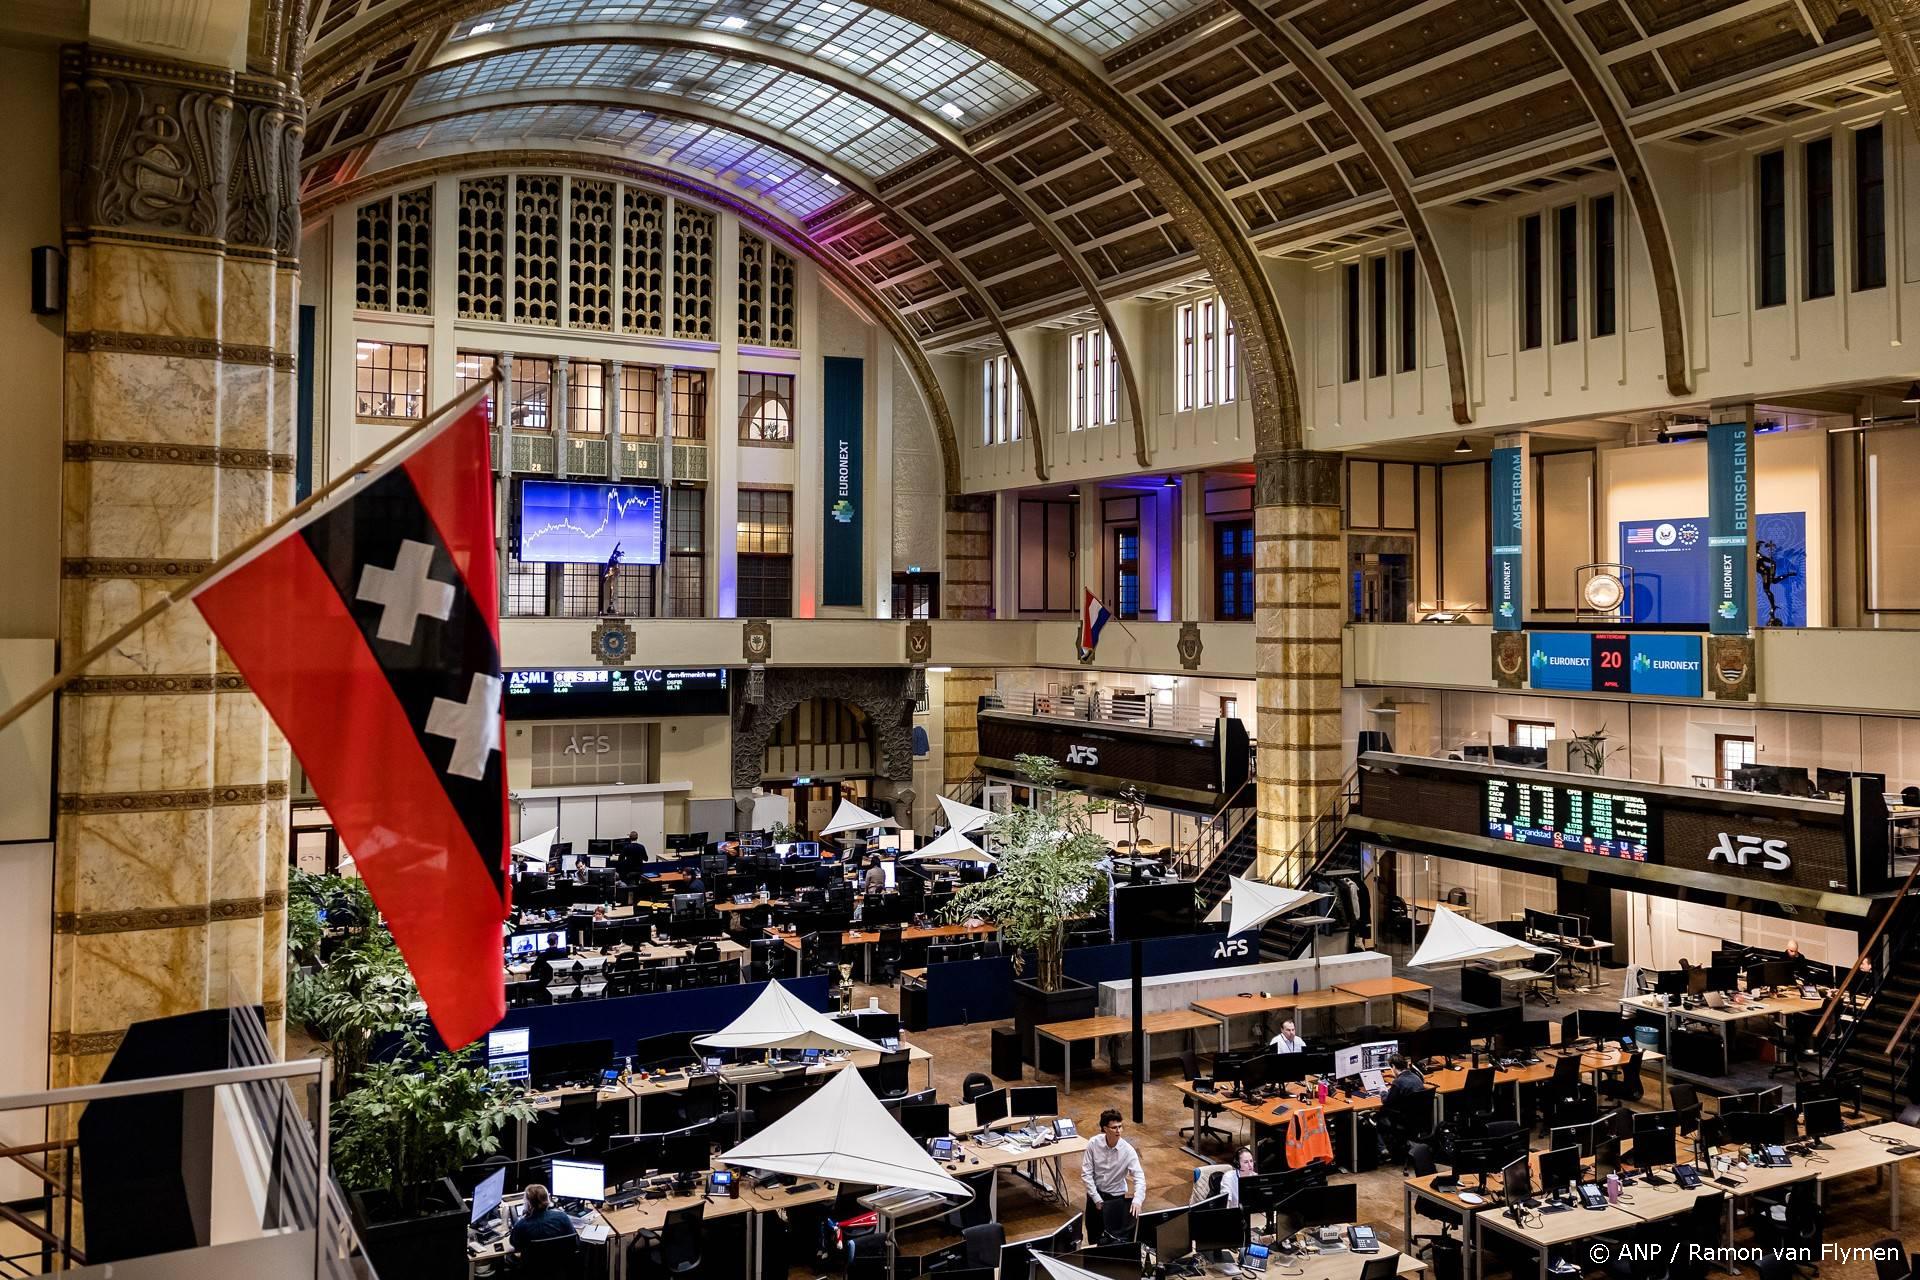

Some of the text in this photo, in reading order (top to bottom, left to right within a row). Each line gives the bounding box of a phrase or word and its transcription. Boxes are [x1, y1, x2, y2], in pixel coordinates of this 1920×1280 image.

[575, 440, 584, 449] 37
[531, 463, 541, 472] 28
[839, 440, 849, 497] EURONEXT
[1734, 430, 1747, 531] BEURSPLEIN 5
[1512, 454, 1522, 530] AMSTERDAM
[1503, 561, 1511, 600] EURONEXT
[1723, 554, 1733, 599] EURONEXT
[1550, 656, 1590, 667] EURONEXT
[1601, 651, 1622, 669] 20
[1653, 660, 1700, 671] EURONEXT
[510, 671, 549, 684] ASML
[634, 669, 662, 681] CVC
[563, 735, 610, 755] AFS
[1066, 744, 1099, 766] AFS
[1593, 792, 1611, 800] CLOSE
[1525, 825, 1551, 839] randstad
[1563, 833, 1581, 844] RELX
[1706, 832, 1792, 871] AFS
[1213, 939, 1249, 959] AFS
